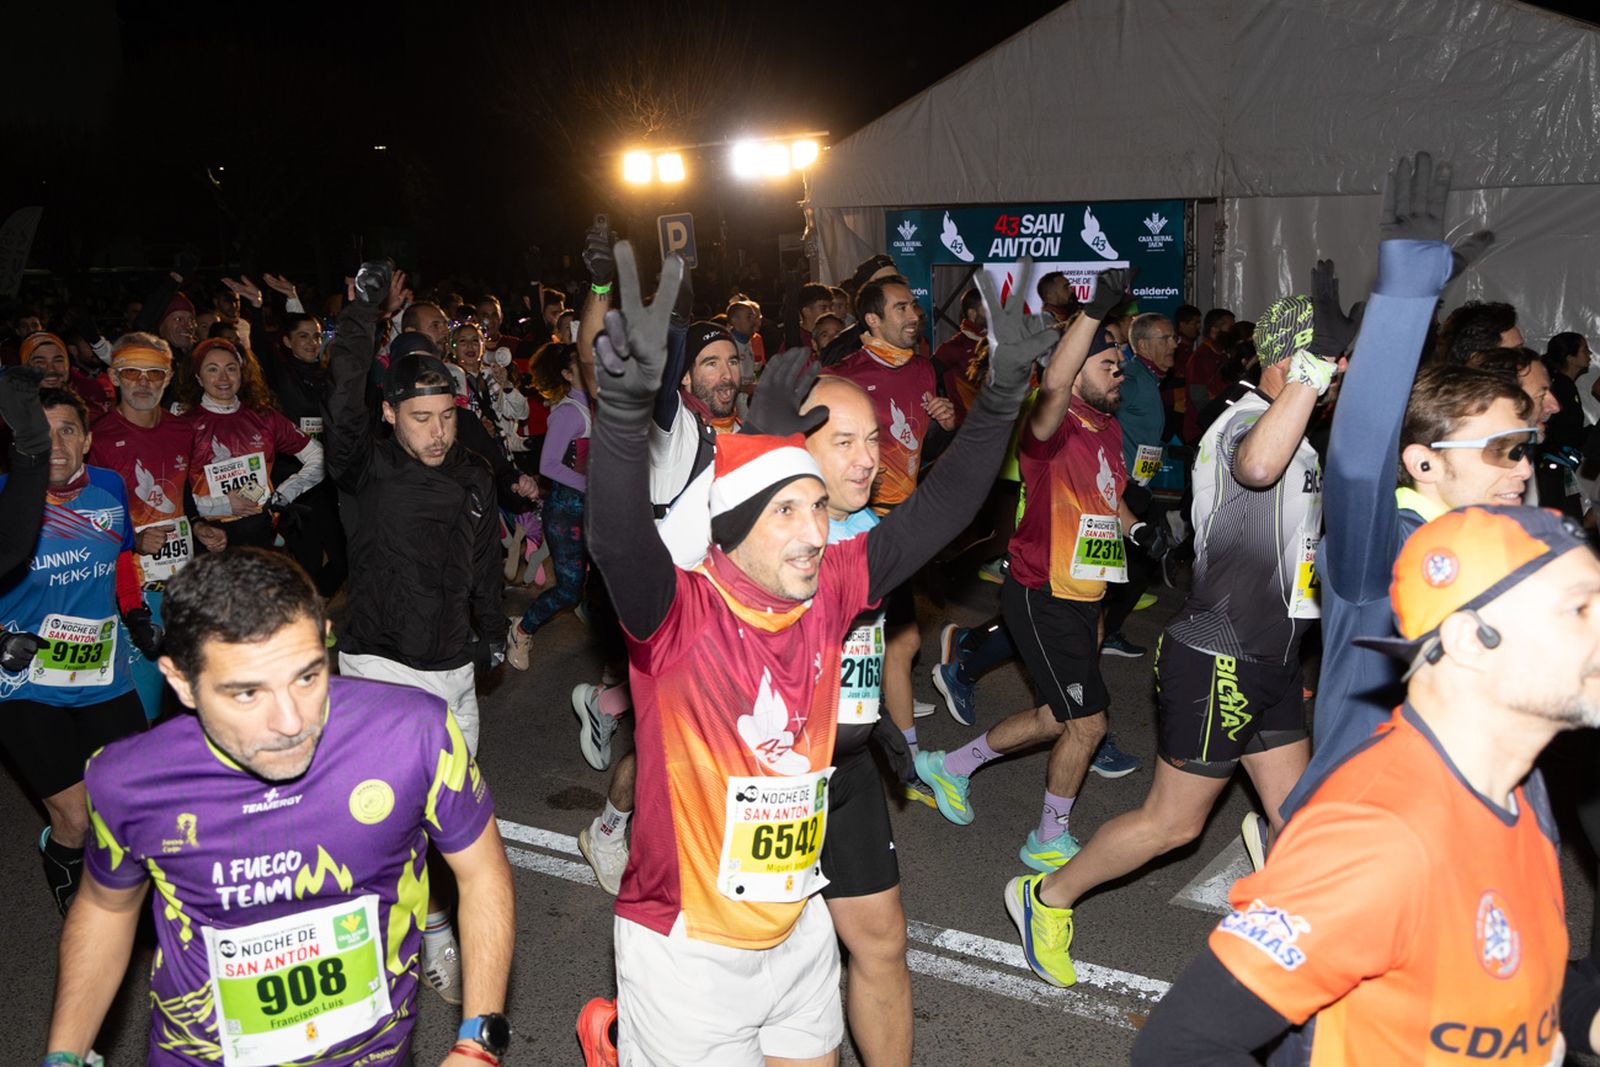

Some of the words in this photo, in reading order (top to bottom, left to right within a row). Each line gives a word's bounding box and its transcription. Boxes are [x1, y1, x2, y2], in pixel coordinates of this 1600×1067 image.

[1020, 213, 1064, 234] SAN
[667, 221, 688, 252] P
[988, 232, 1060, 258] ANTÓN
[1091, 236, 1106, 251] 43
[1133, 285, 1178, 296] calderón
[215, 474, 227, 482] SAN
[1085, 539, 1124, 560] 12312
[48, 630, 67, 640] SAN
[60, 624, 87, 634] NOCHE
[51, 641, 103, 664] 9133
[1215, 655, 1241, 728] BICHA
[242, 795, 303, 814] TEAMERGY
[760, 791, 798, 804] NOCHE
[800, 788, 810, 802] DE
[744, 807, 770, 821] SAN
[751, 816, 818, 861] 6542
[230, 849, 302, 882] FUEGO
[216, 875, 293, 911] TEAM
[241, 936, 293, 959] NOCHE
[298, 927, 318, 943] DE
[225, 959, 259, 978] SAN
[256, 956, 348, 1017] 908
[270, 1006, 321, 1030] Francisco
[321, 999, 345, 1012] Luis
[1429, 1021, 1530, 1060] CDA
